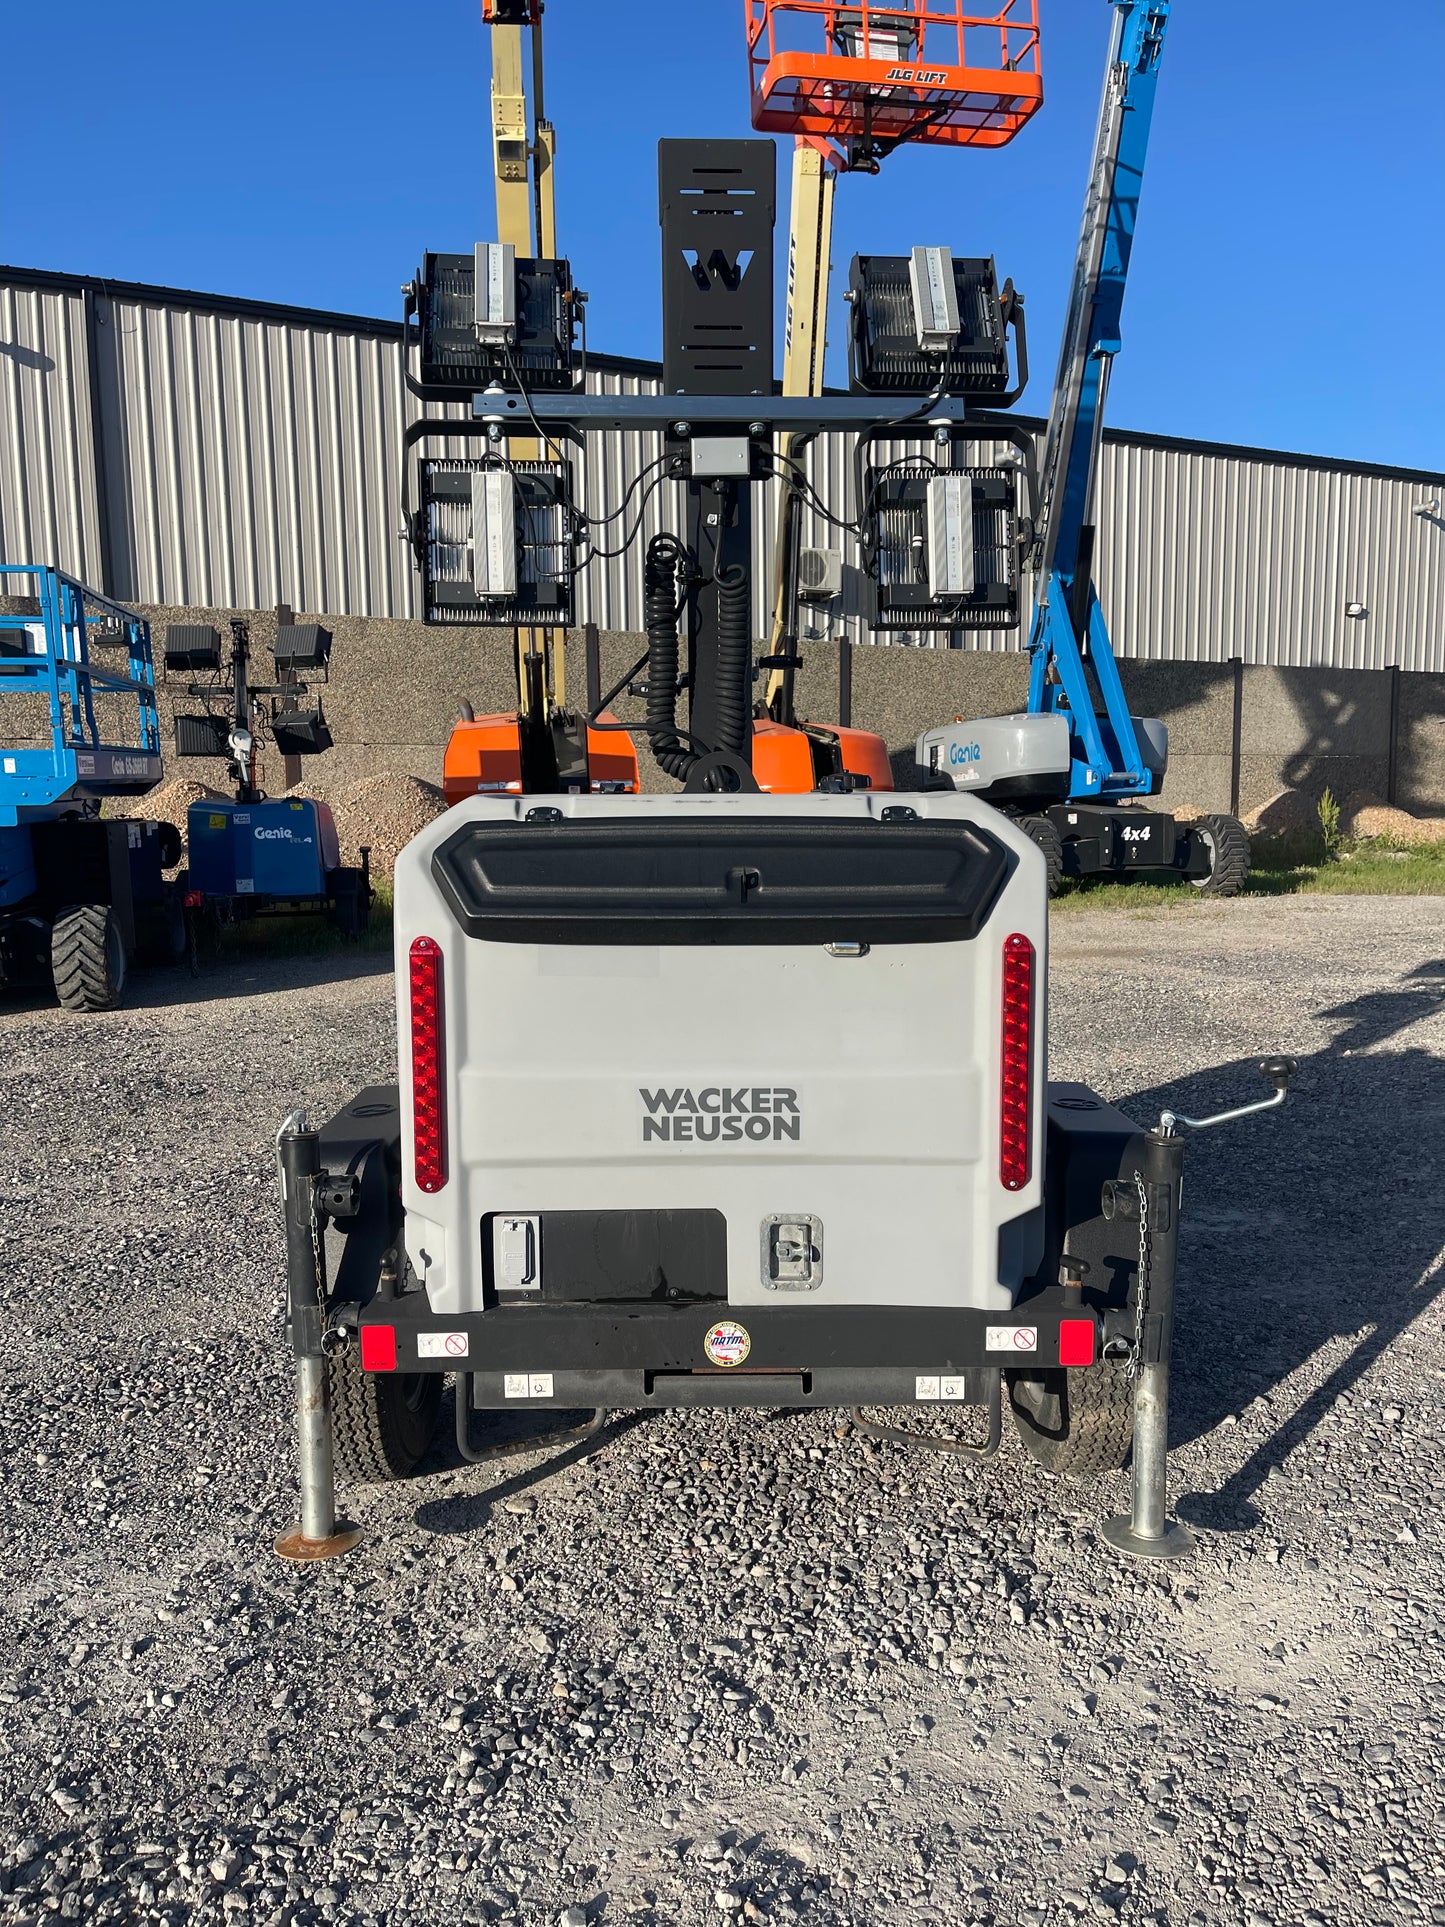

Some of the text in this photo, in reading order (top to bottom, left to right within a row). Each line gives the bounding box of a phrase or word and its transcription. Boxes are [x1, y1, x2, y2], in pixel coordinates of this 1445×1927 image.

[886, 68, 947, 84] JLG LIFT
[785, 232, 796, 357] JLG LIFT
[949, 741, 981, 765] Genie
[254, 827, 293, 839] Genie
[1121, 825, 1151, 841] 4x4
[638, 1087, 801, 1115] WACKER
[643, 1114, 801, 1142] NEUSON
